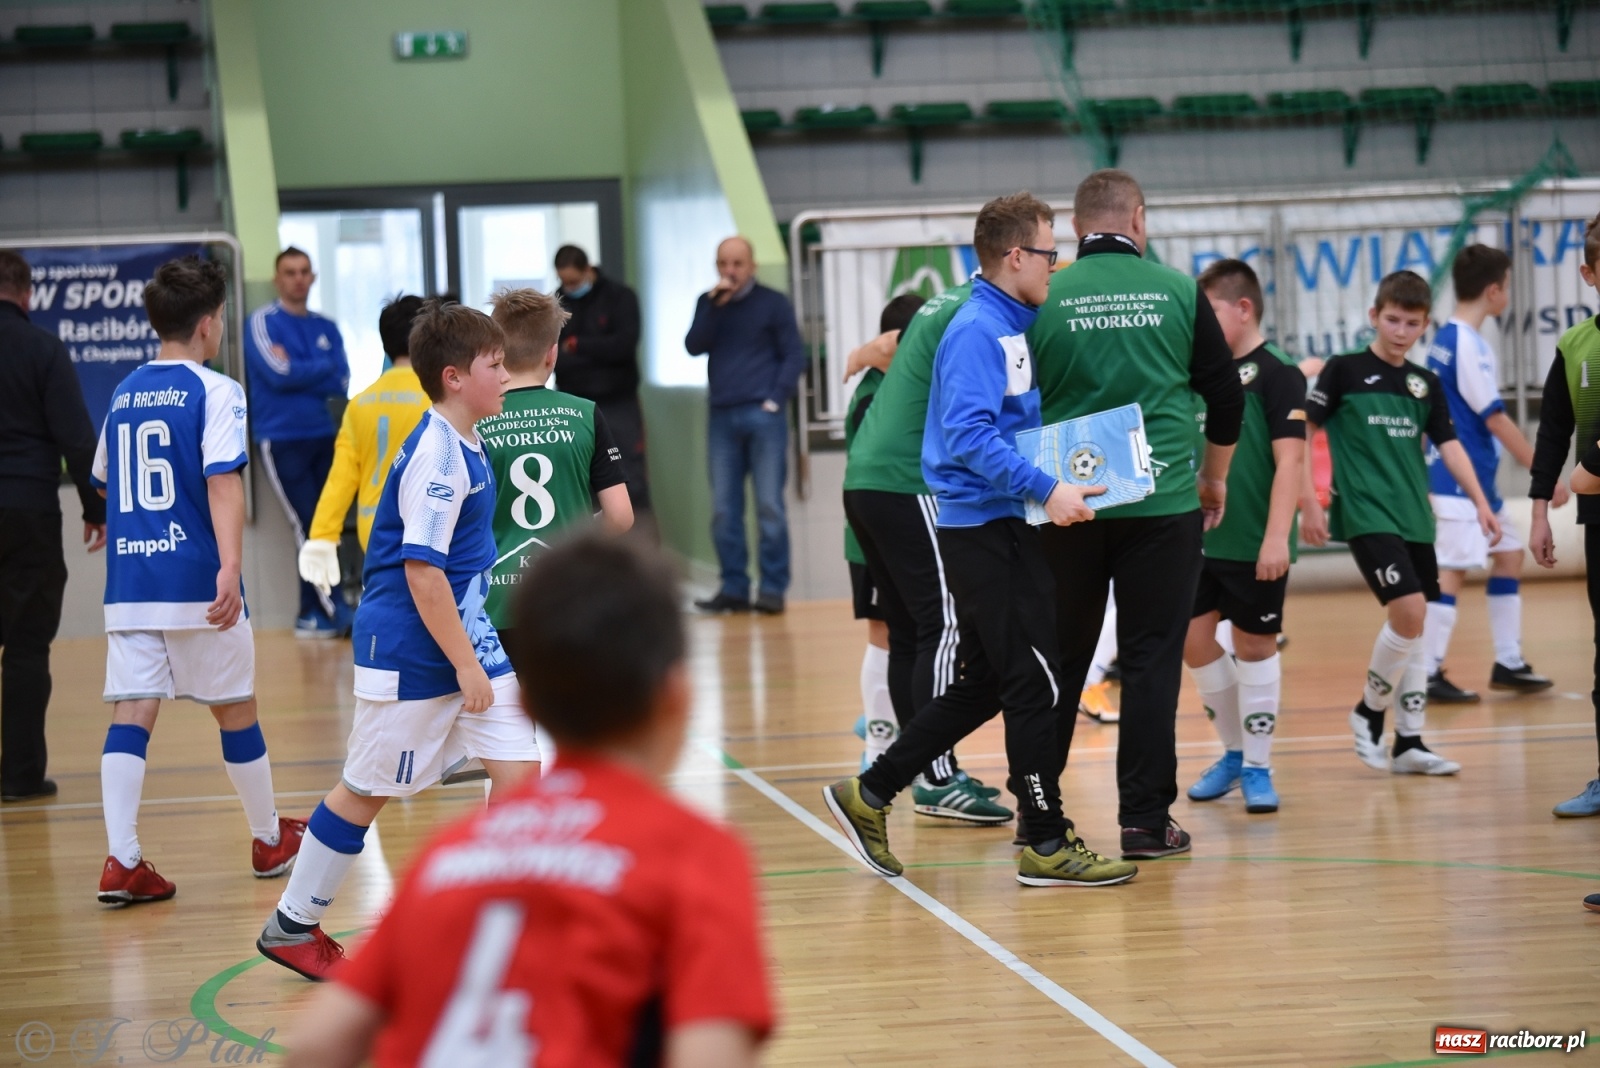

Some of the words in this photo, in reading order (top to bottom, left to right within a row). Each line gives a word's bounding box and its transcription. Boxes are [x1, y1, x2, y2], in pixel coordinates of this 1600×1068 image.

[48, 263, 118, 281] sportowy
[63, 279, 152, 310] SPOR
[1059, 294, 1112, 307] AKADEMIA
[1113, 293, 1169, 301] PIŁKARSKA
[1075, 303, 1125, 314] MŁODEGO
[1067, 311, 1164, 332] TWORKÓW
[82, 344, 144, 364] Chopina
[133, 386, 189, 408] RACIBÓRZ
[473, 411, 521, 430] KADEMIA
[523, 407, 584, 418] PIŁKARSKA
[482, 420, 536, 435] MŁODEGO
[539, 417, 569, 427] LKS-u
[118, 420, 176, 513] 16
[509, 453, 555, 530] 8
[116, 534, 177, 557] Empol
[1374, 562, 1401, 588] 16
[396, 750, 414, 784] 11
